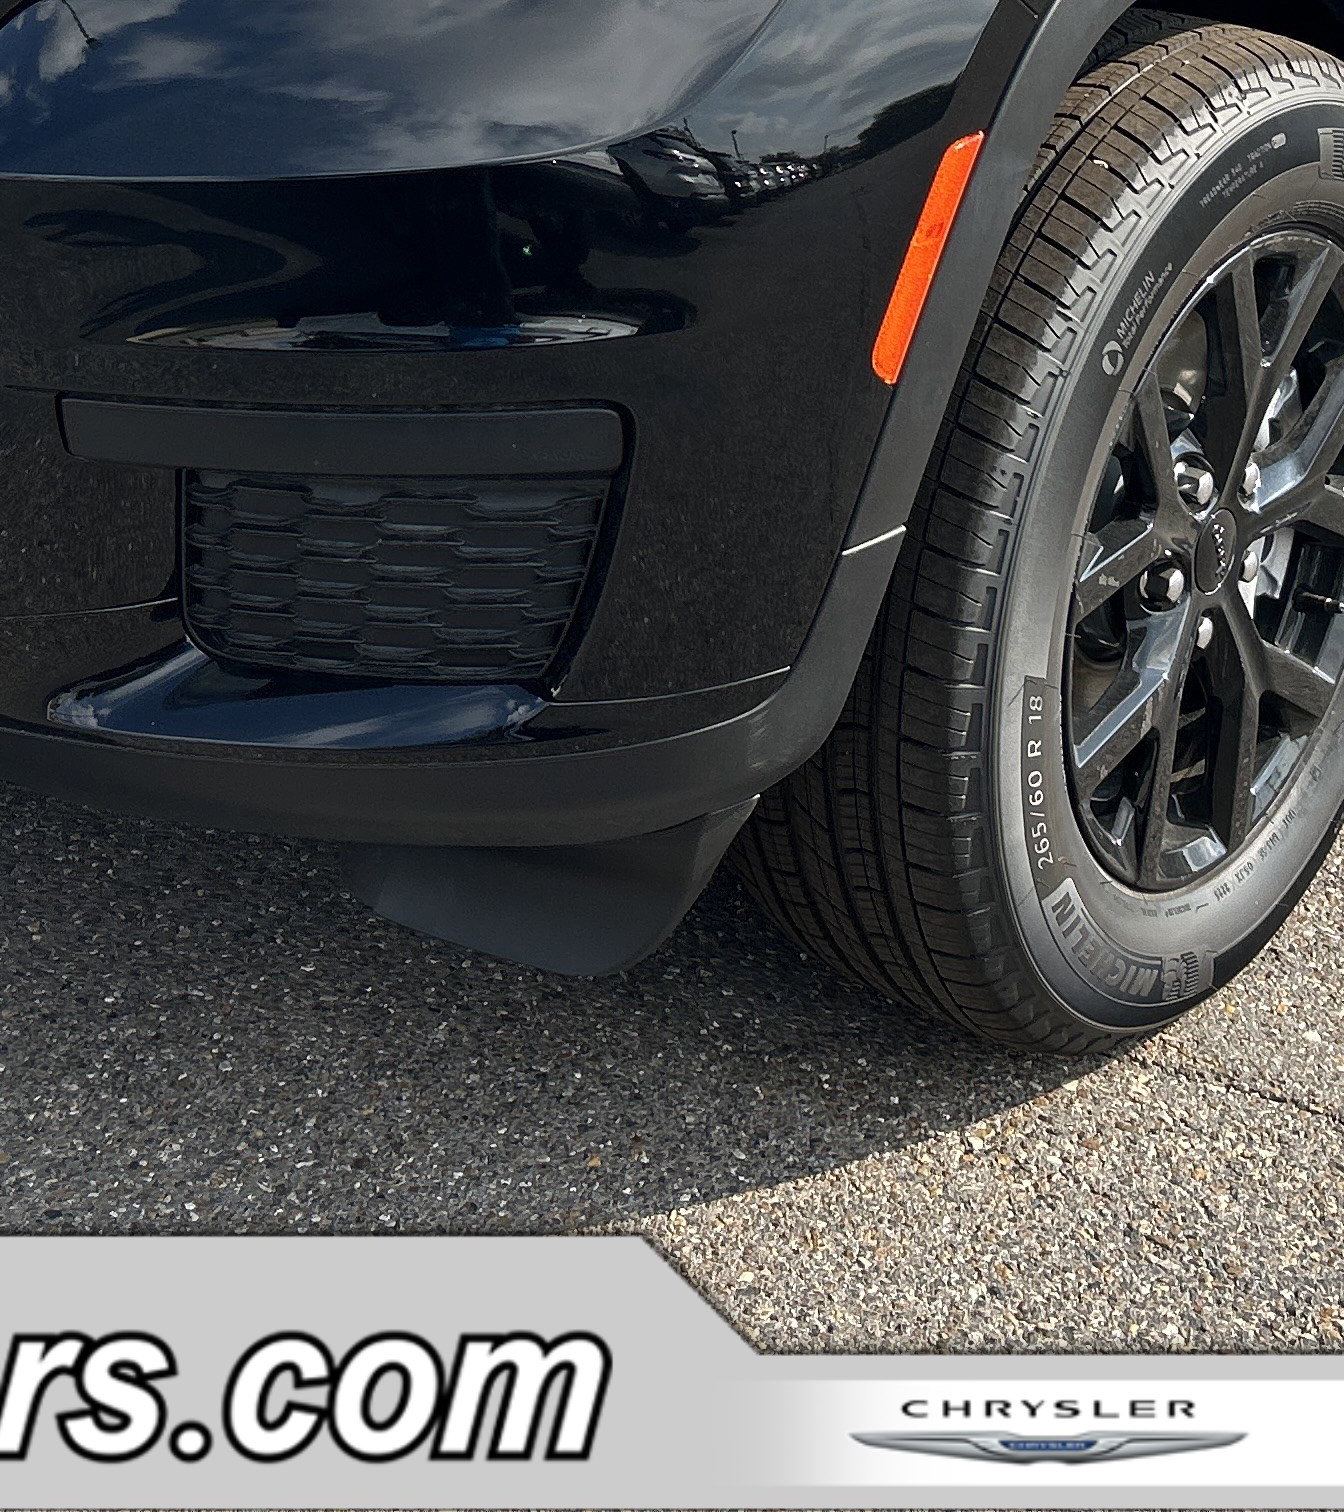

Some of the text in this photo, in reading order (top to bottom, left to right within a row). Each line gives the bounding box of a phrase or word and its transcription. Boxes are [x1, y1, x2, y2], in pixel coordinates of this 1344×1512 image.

[1116, 270, 1155, 339] MICHELIN
[1027, 695, 1055, 870] 265/60 R 18
[1051, 891, 1159, 997] MICHELIN
